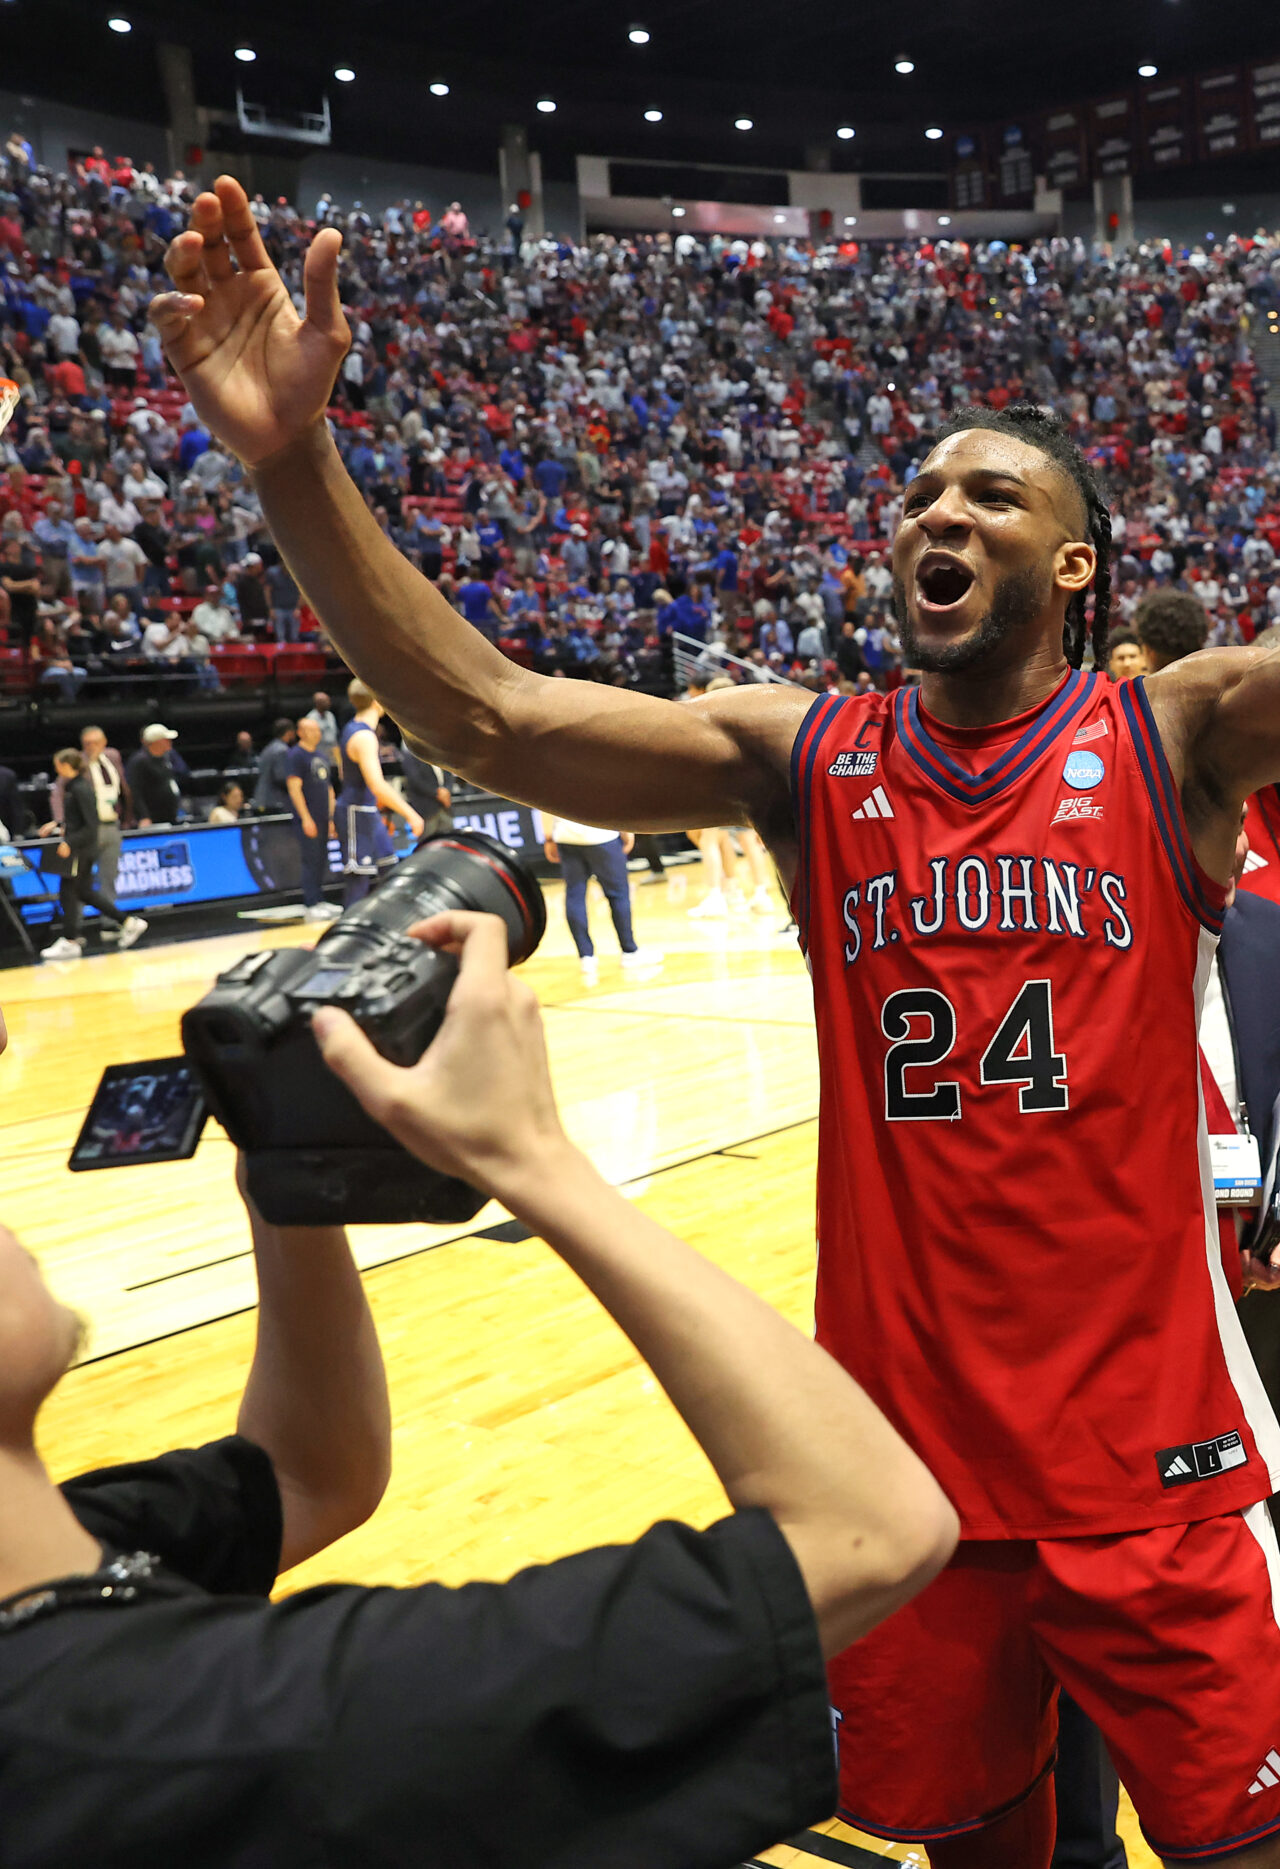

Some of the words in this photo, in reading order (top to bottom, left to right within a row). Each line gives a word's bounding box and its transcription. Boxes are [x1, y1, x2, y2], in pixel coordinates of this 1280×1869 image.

[836, 753, 853, 765] BE
[856, 752, 878, 765] THE
[828, 764, 876, 776] CHANGE
[1067, 767, 1102, 779] NCAA
[1058, 797, 1094, 809] BIG
[1054, 806, 1104, 820] EAST
[117, 849, 160, 872] ARCH
[841, 868, 900, 968] ST.
[909, 853, 1135, 952] JOHN'S
[880, 978, 1069, 1122] 24
[1215, 1188, 1229, 1198] OND
